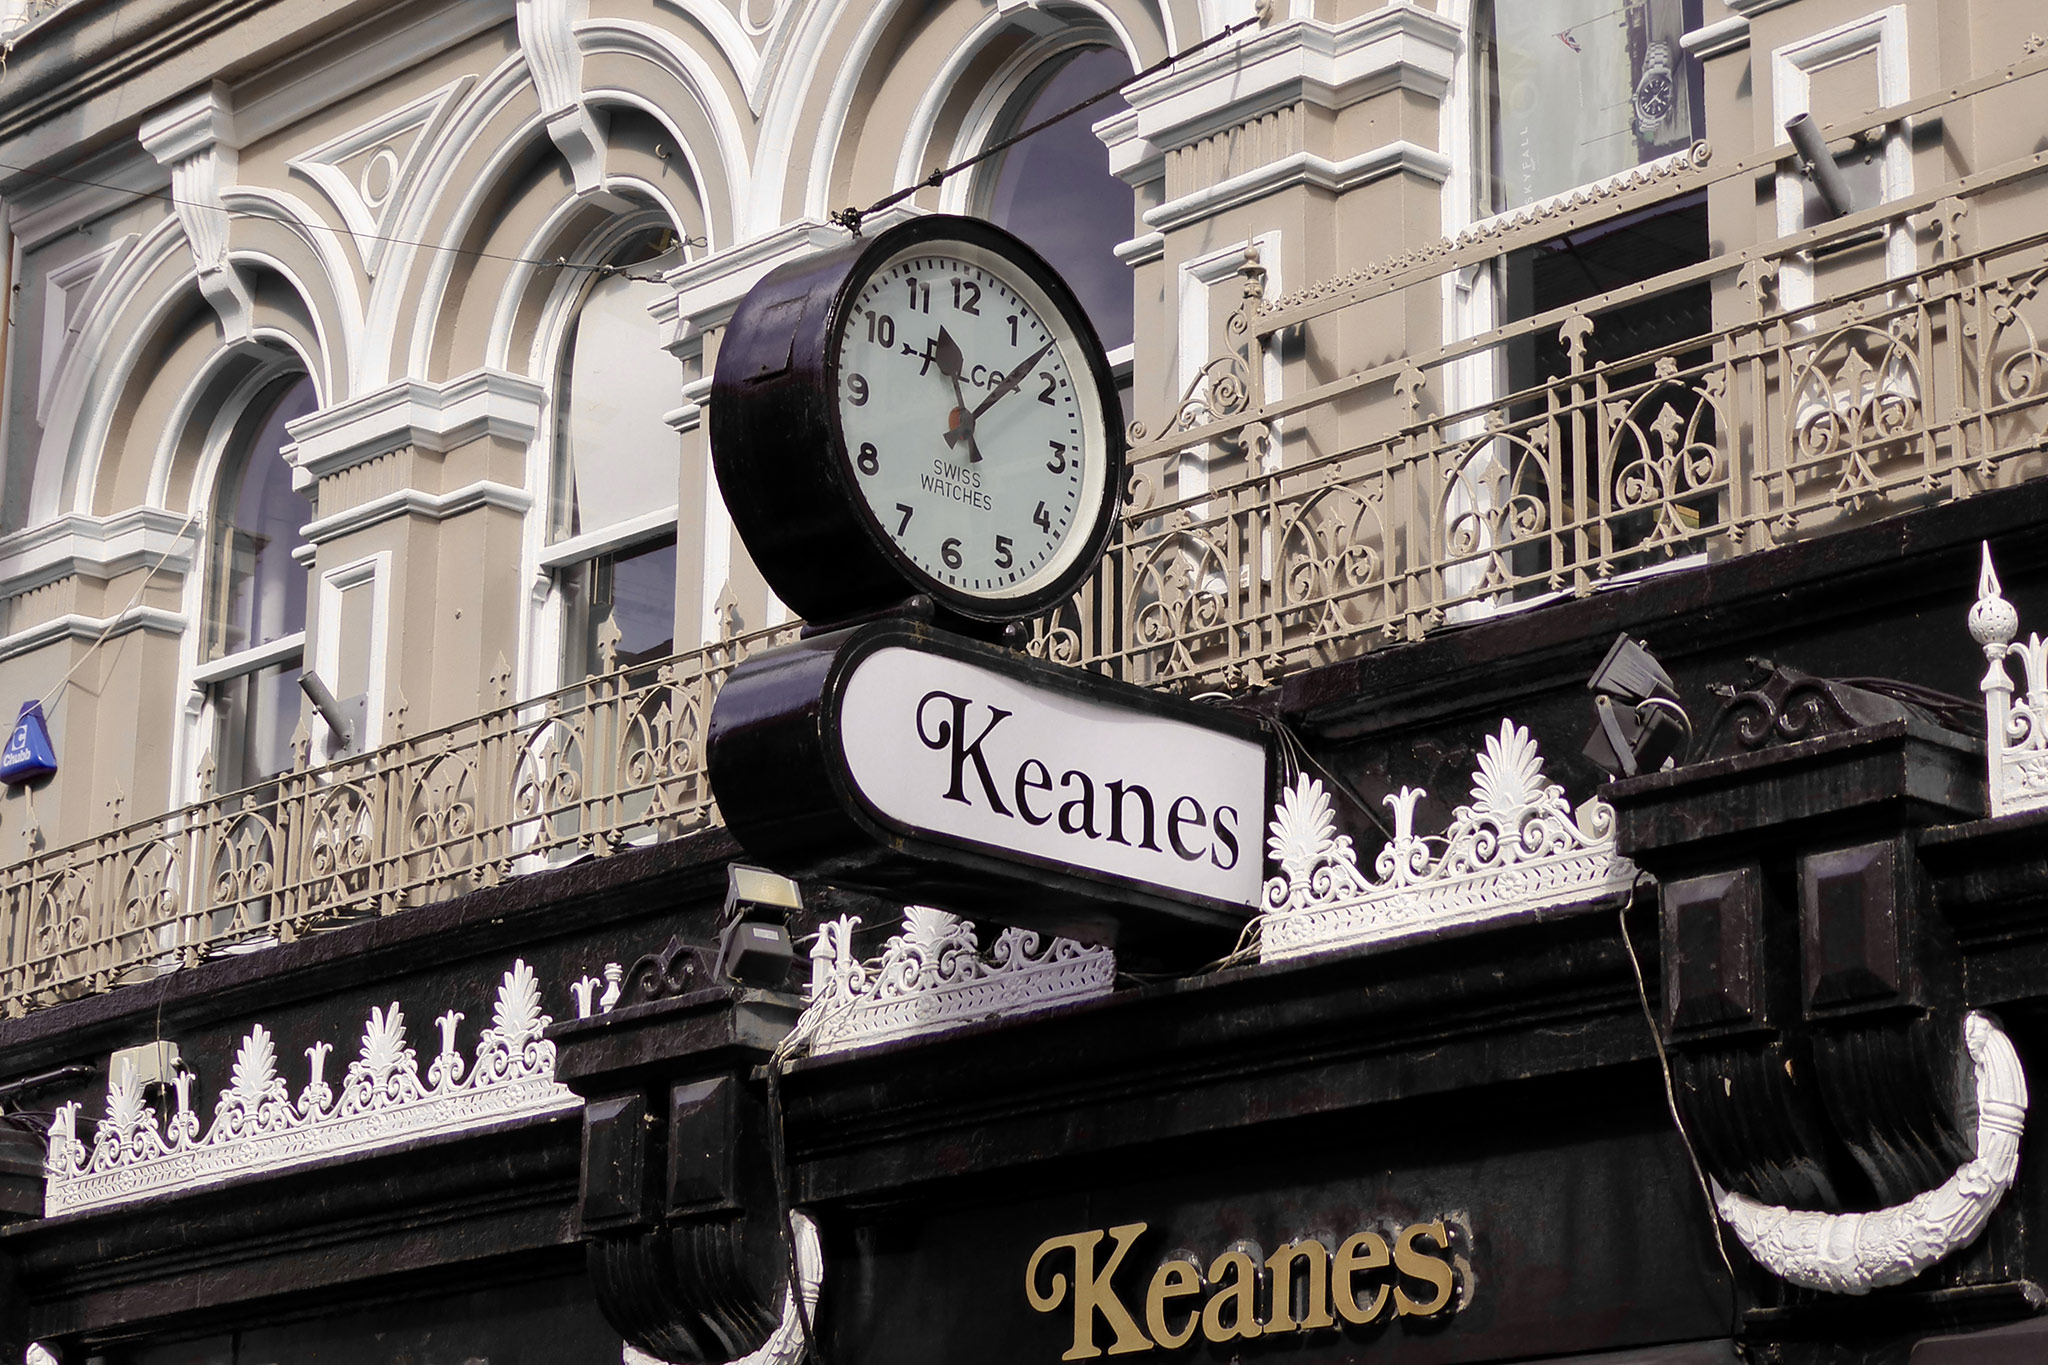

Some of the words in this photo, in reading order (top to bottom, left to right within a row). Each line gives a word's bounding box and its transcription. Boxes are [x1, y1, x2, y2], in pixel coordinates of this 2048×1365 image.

[1520, 126, 1534, 205] SKYFALL
[906, 277, 930, 314] 11
[950, 277, 981, 316] 12
[865, 311, 895, 348] 10
[1007, 315, 1018, 346] 1
[847, 373, 869, 406] 9
[1038, 372, 1056, 406] 2
[857, 442, 879, 475] 8
[934, 459, 981, 488] SWISS
[1047, 440, 1065, 474] 3
[920, 473, 992, 511] WATCHES
[895, 503, 914, 536] 7
[1033, 501, 1051, 534] 4
[941, 538, 963, 569] 6
[995, 535, 1013, 568] 5
[3, 747, 31, 767] Chubb
[916, 690, 1239, 870] Keanes
[1025, 1221, 1453, 1361] Keanes
